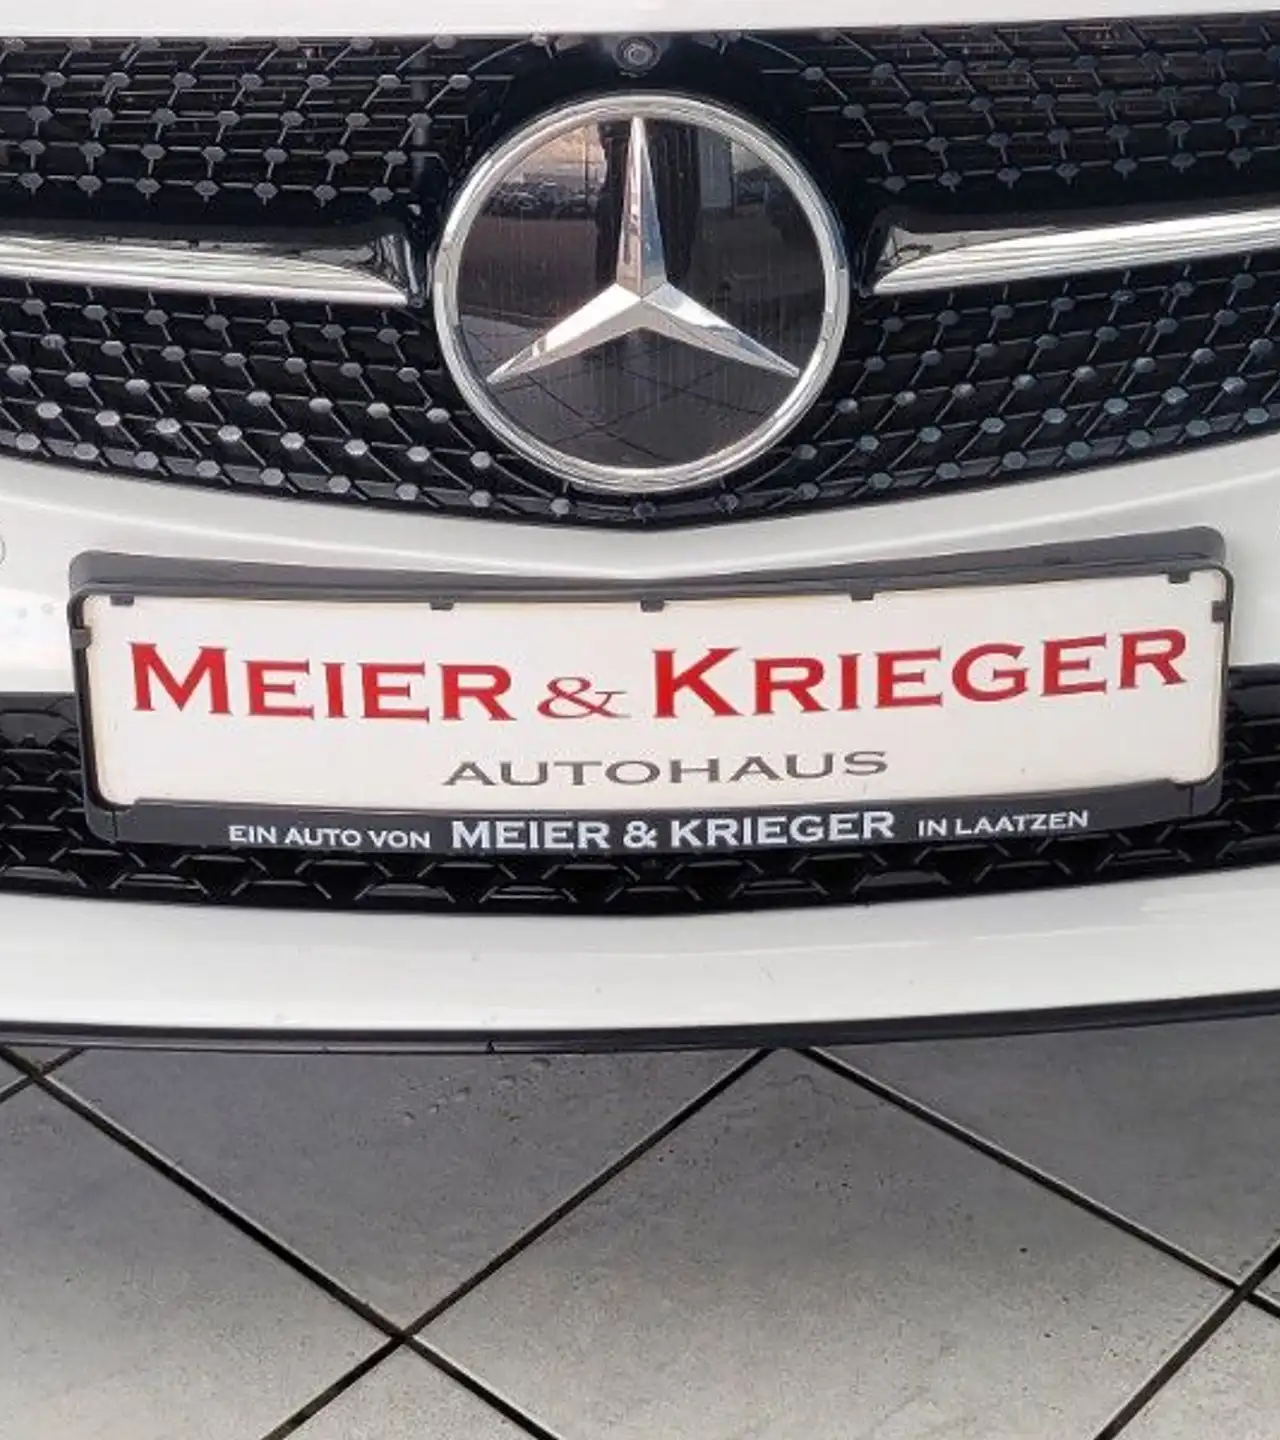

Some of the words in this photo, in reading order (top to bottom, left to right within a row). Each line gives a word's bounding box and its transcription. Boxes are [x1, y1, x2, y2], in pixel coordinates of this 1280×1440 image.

[130, 641, 517, 724] MEIER
[536, 676, 631, 720] &
[652, 629, 1187, 719] KRIEGER
[442, 750, 888, 787] AUTOHAUS
[228, 824, 277, 846] EIN
[283, 827, 363, 848] AUTO
[366, 830, 431, 849] VON
[452, 819, 611, 850] MEIER
[623, 819, 659, 849] &
[670, 810, 896, 848] KRIEGER
[917, 817, 948, 837] IN
[954, 809, 1090, 836] LAATZEN
